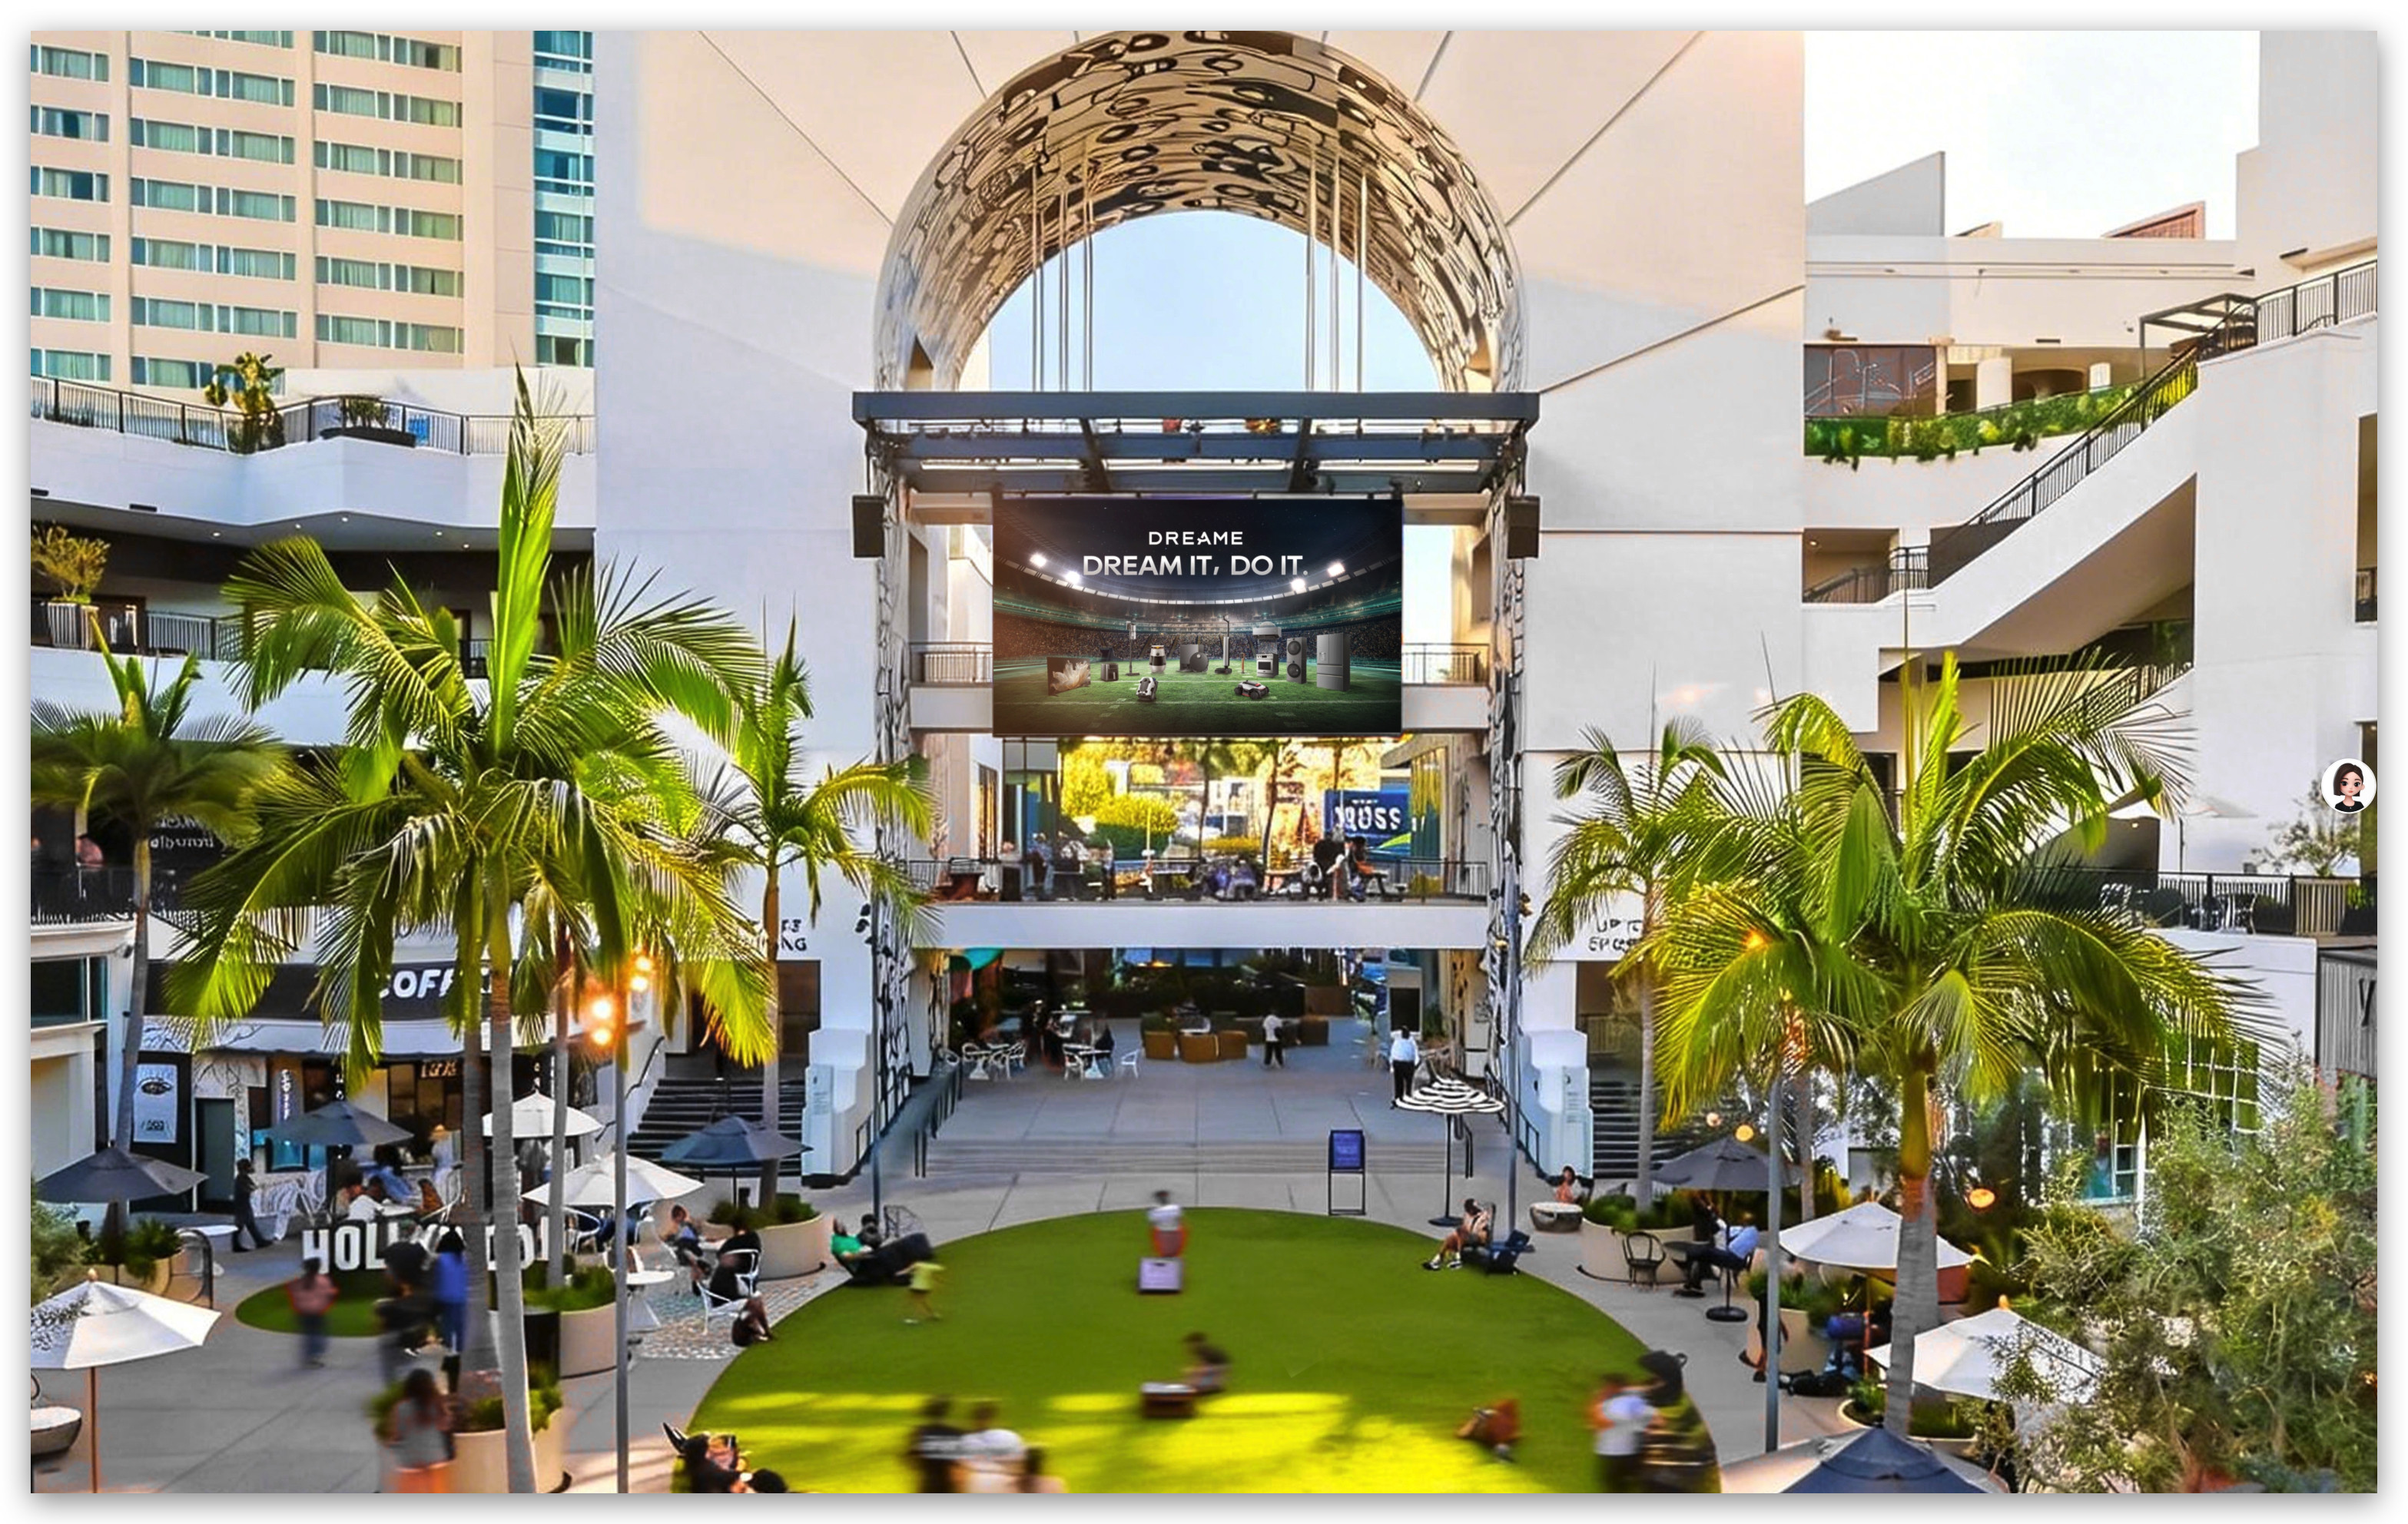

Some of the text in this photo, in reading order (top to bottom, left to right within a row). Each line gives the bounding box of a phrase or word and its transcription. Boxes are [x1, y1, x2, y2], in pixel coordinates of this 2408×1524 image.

[1149, 532, 1243, 545] DREAME
[1083, 555, 1308, 576] DREAM IT, DO IT.
